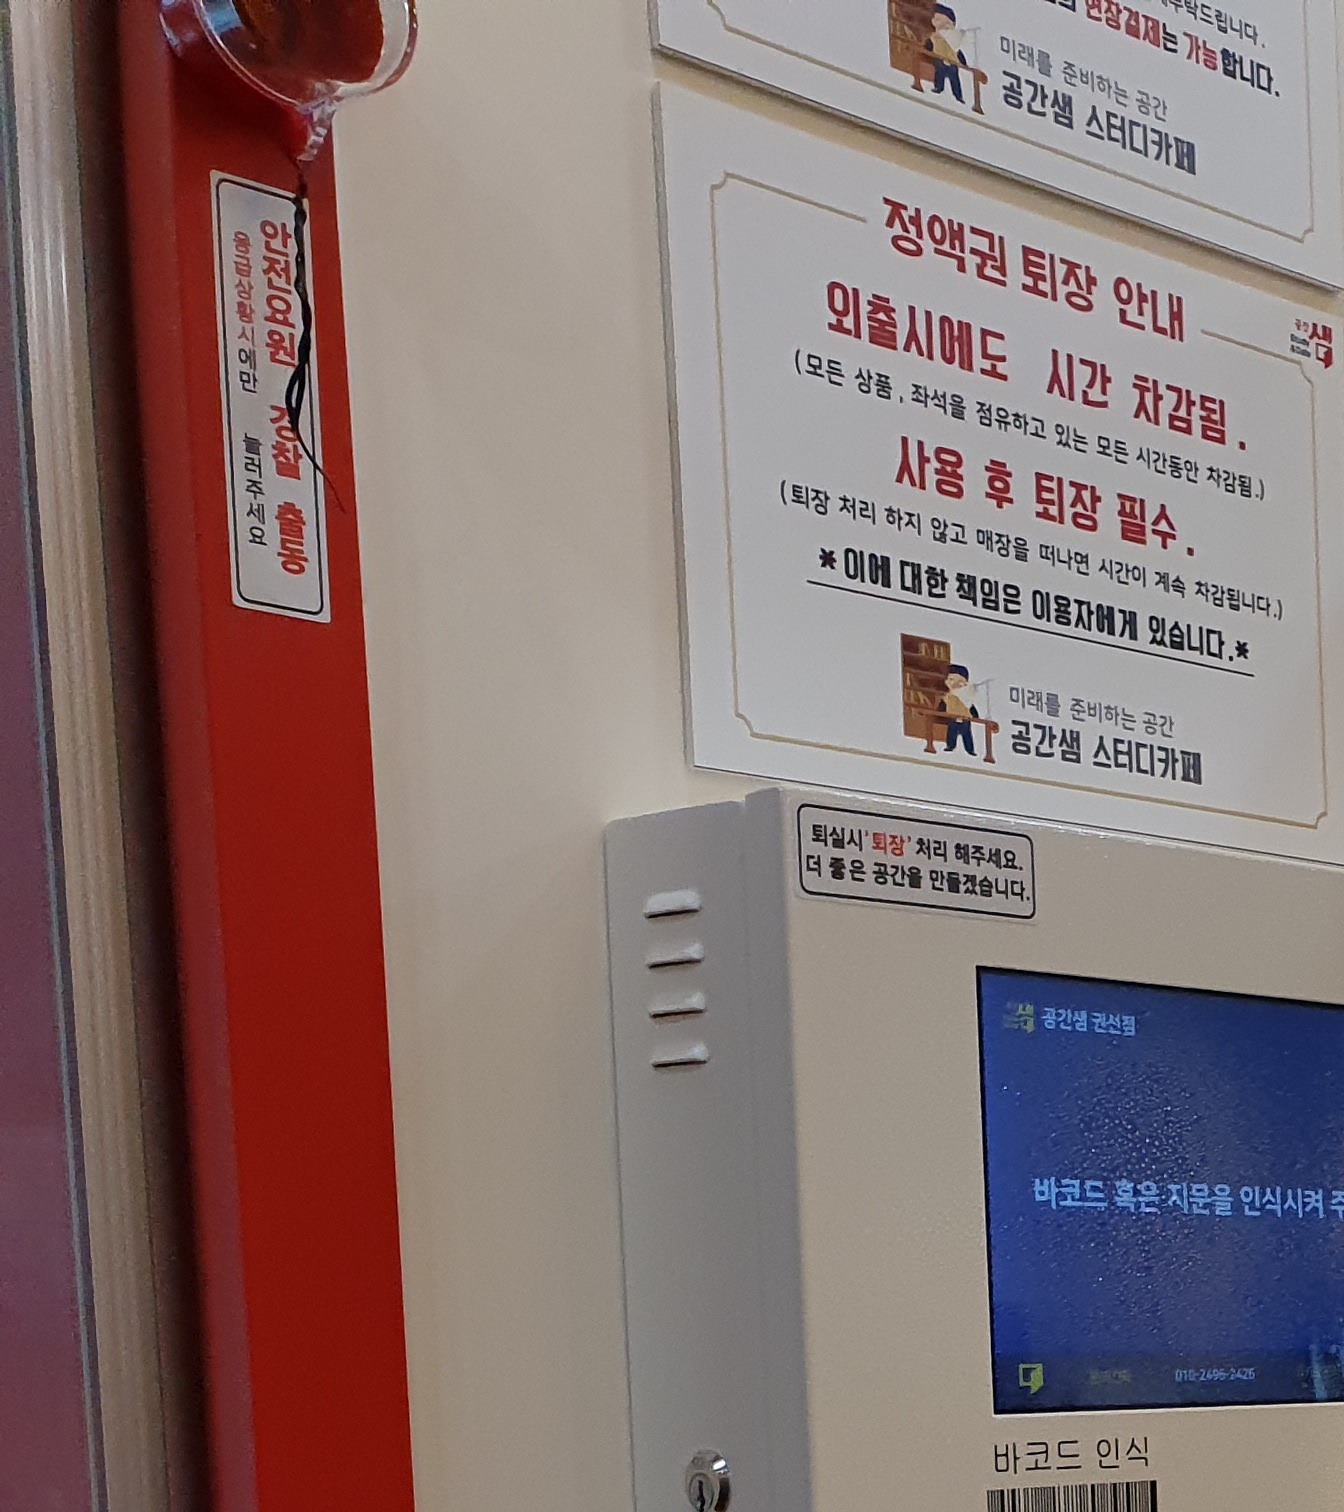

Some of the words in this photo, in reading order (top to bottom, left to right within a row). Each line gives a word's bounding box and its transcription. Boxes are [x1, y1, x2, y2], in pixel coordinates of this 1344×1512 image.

[999, 35, 1053, 77] 미래를
[1062, 60, 1129, 109] 준비하는
[1135, 89, 1168, 123] 공간
[1183, 32, 1280, 97] 가능합니다.
[1002, 70, 1074, 130] 공간샘
[1085, 105, 1197, 175] 스터디카페
[260, 219, 298, 369] 안전요원
[882, 196, 1008, 288] 정액권
[1021, 244, 1098, 313] 퇴장
[1113, 276, 1185, 343] 안내
[826, 281, 1009, 382] 외출시에도
[1046, 349, 1112, 409] 시간
[1132, 374, 1246, 451] 차감됨.
[795, 348, 846, 388] (모든
[911, 383, 967, 421] 좌석을
[975, 400, 1047, 440] 점유하고
[1055, 423, 1089, 454] 있는
[1096, 435, 1130, 465] 모든
[1136, 447, 1201, 485] 시간동안
[895, 435, 964, 500] 사용
[984, 459, 1014, 510] 후
[1034, 471, 1102, 533] 퇴장
[1116, 492, 1195, 557] 필수.
[780, 480, 830, 516] (퇴장
[838, 494, 876, 525] 처리
[884, 505, 922, 536] 하지
[930, 517, 968, 545] 않고
[976, 529, 1030, 563] 매장을
[1039, 543, 1090, 576] 떠나면
[1098, 558, 1146, 588] 시간이
[1154, 571, 1186, 598] 계속
[900, 560, 948, 599] 대한
[955, 571, 1021, 615] 책임은
[1032, 588, 1139, 641] 이용자에게
[1009, 686, 1061, 718] 미래를
[1069, 696, 1137, 732] 준비하는
[1143, 711, 1175, 739] 공간
[1010, 719, 1081, 764] 공간샘
[1093, 735, 1203, 785] 스터디카페
[806, 853, 822, 877] 더
[829, 857, 867, 882] 좋은
[872, 862, 923, 890] 공간을
[929, 869, 1031, 902] 만들겠습니다.
[811, 824, 863, 852] 퇴실시
[916, 836, 948, 862] 처리
[954, 842, 1024, 872] 해주세요.
[1033, 1177, 1108, 1210] 바코드
[1113, 1178, 1161, 1213] 혹은
[1167, 1182, 1234, 1217] 지문을
[1239, 1185, 1324, 1220] 인식시켜
[993, 1440, 1083, 1475] 바코드
[1096, 1437, 1149, 1468] 인식
